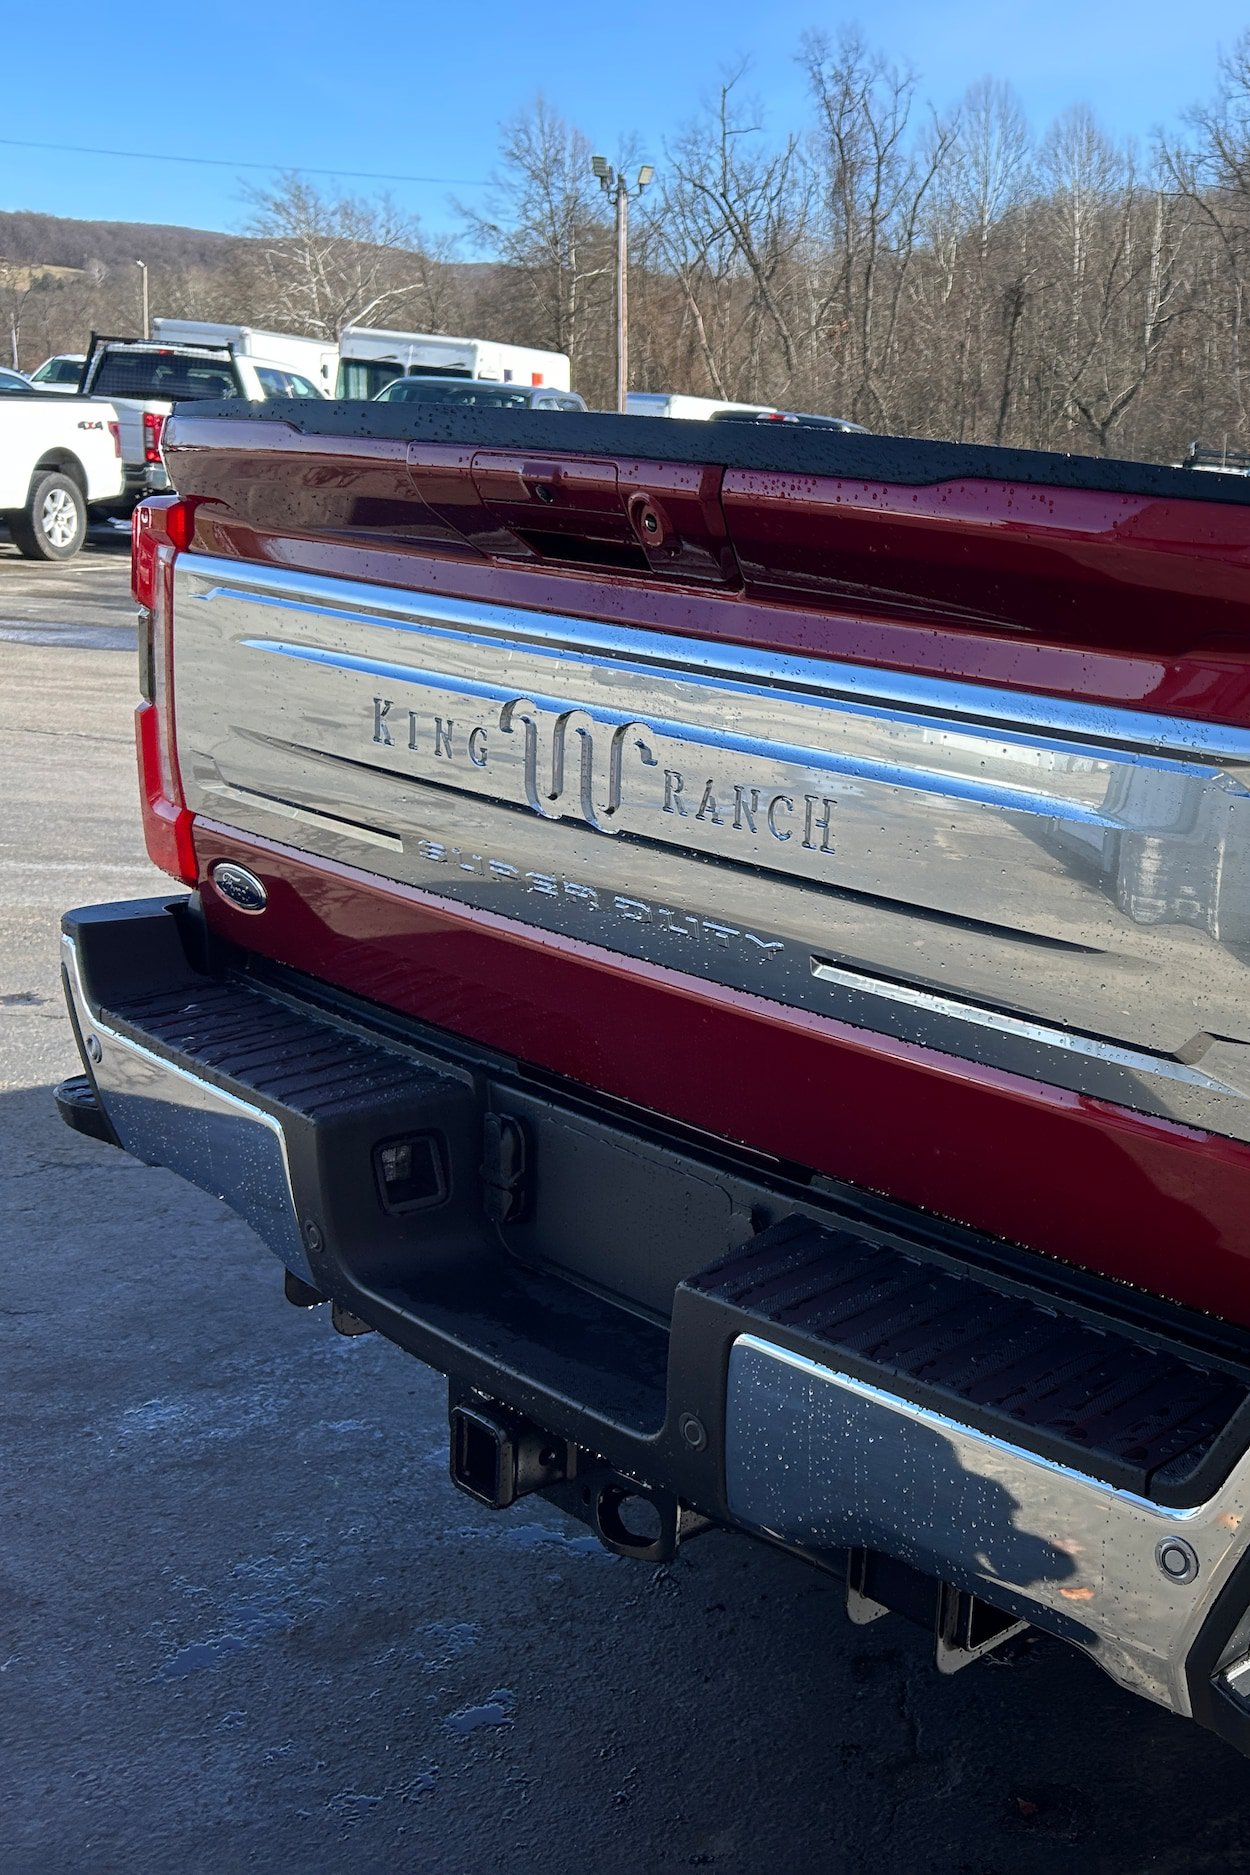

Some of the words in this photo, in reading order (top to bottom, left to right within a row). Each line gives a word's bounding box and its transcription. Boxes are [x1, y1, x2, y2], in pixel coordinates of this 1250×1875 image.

[373, 698, 488, 767] KING
[662, 769, 838, 855] RANCH
[417, 838, 600, 910] SUPER
[614, 895, 786, 961] DUTY
